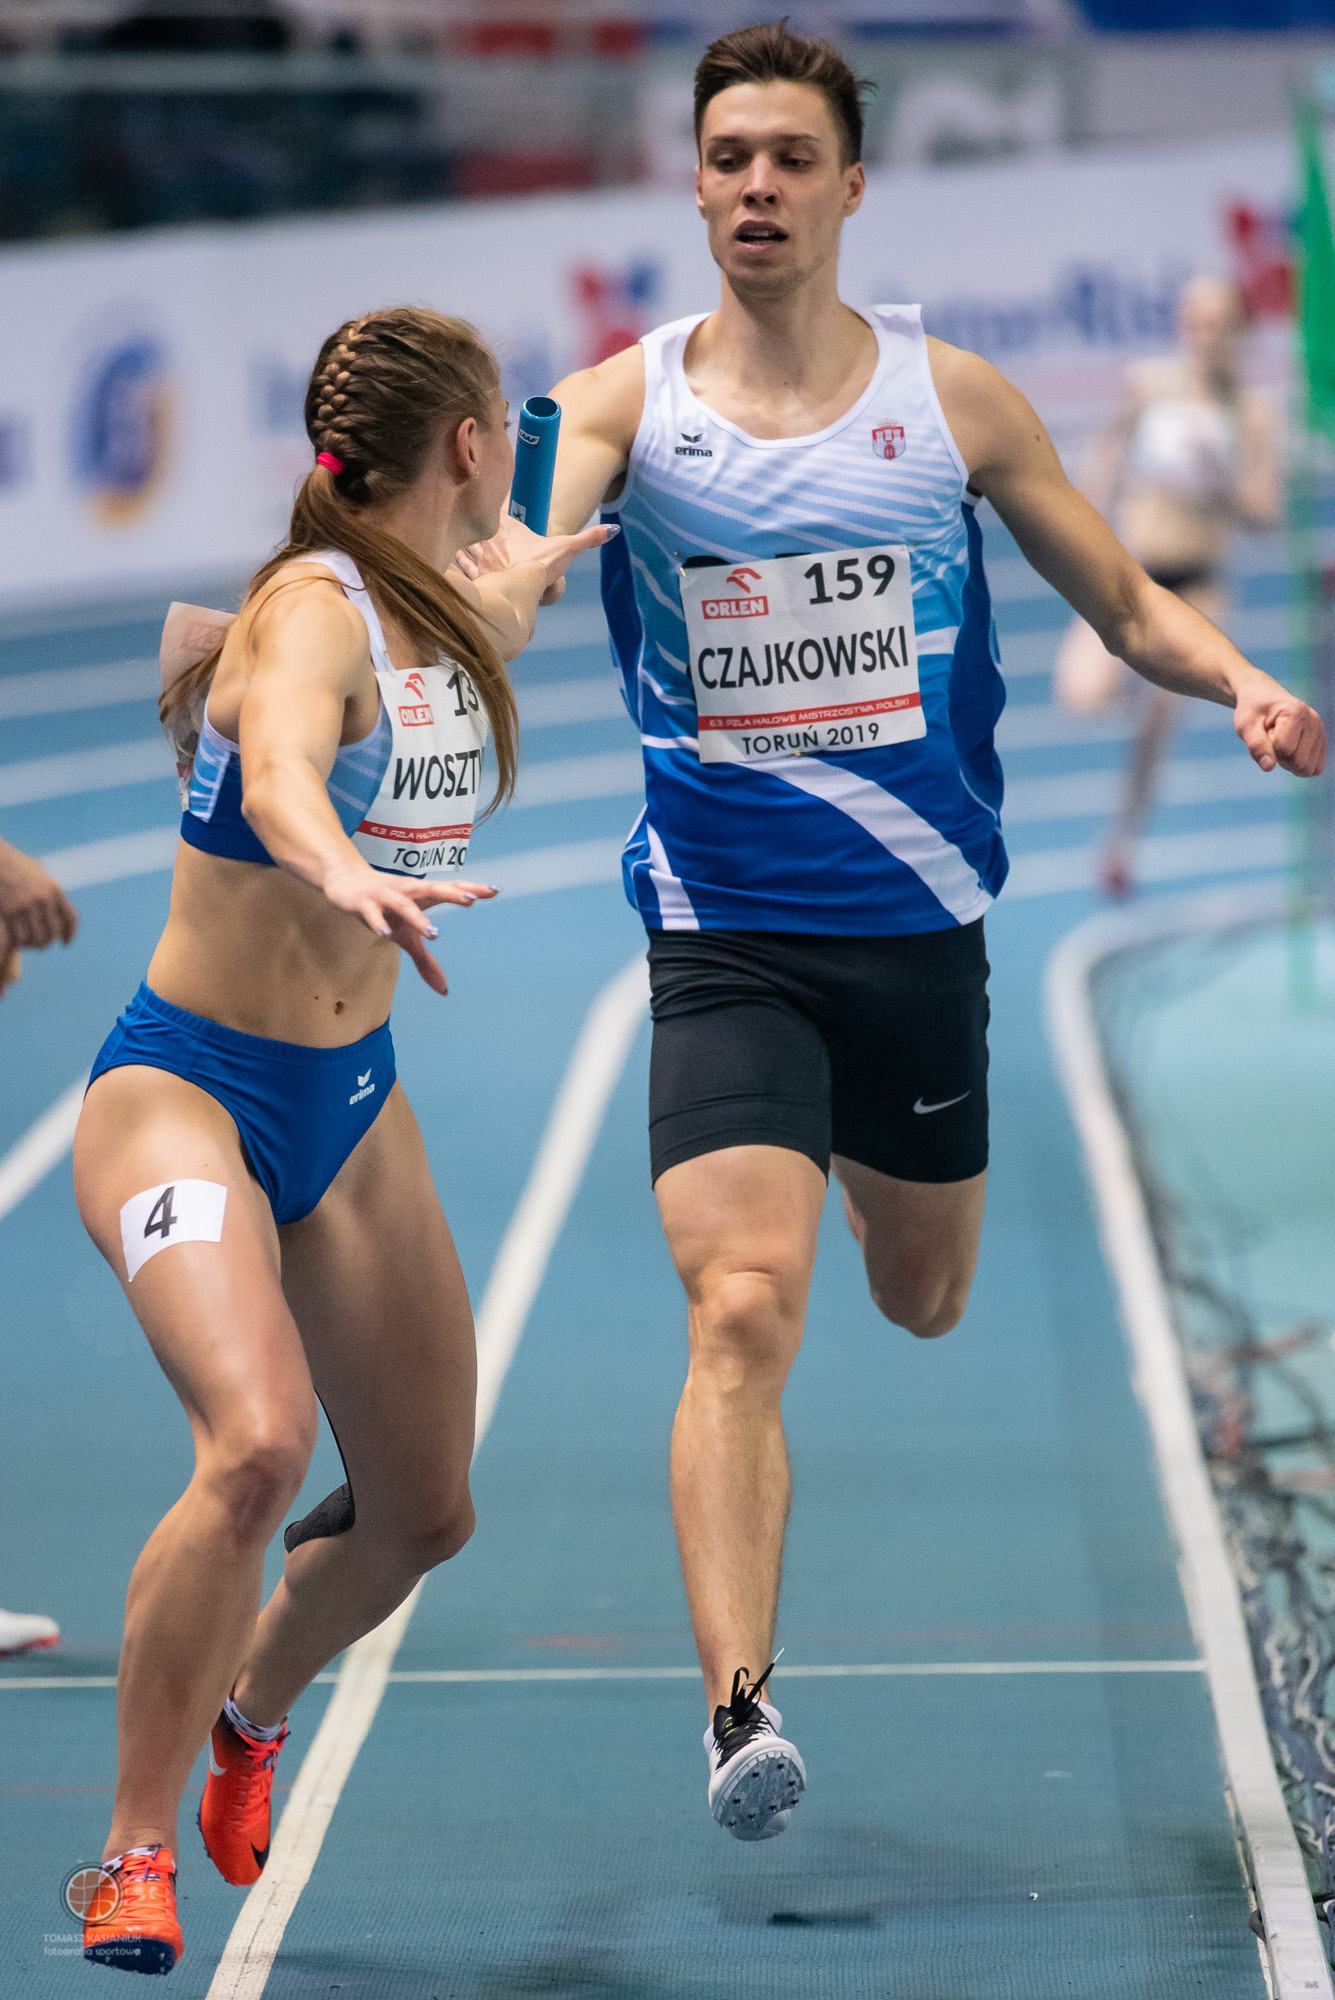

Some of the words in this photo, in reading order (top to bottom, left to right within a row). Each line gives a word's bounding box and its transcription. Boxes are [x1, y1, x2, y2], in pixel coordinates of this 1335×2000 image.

[674, 445, 713, 457] erima
[803, 554, 896, 606] 159
[704, 598, 765, 617] ORLEN
[697, 625, 909, 690] CZAJKOWSKI
[726, 718, 750, 728] PZLA
[752, 714, 797, 726] HALOWE
[798, 704, 874, 721] MISTRZOSTWA
[875, 698, 910, 711] POLSKI
[742, 724, 819, 755] TORUŃ
[826, 722, 880, 747] 2019
[393, 749, 482, 801] WOSZT
[349, 1083, 376, 1106] erima
[143, 1185, 179, 1240] 4
